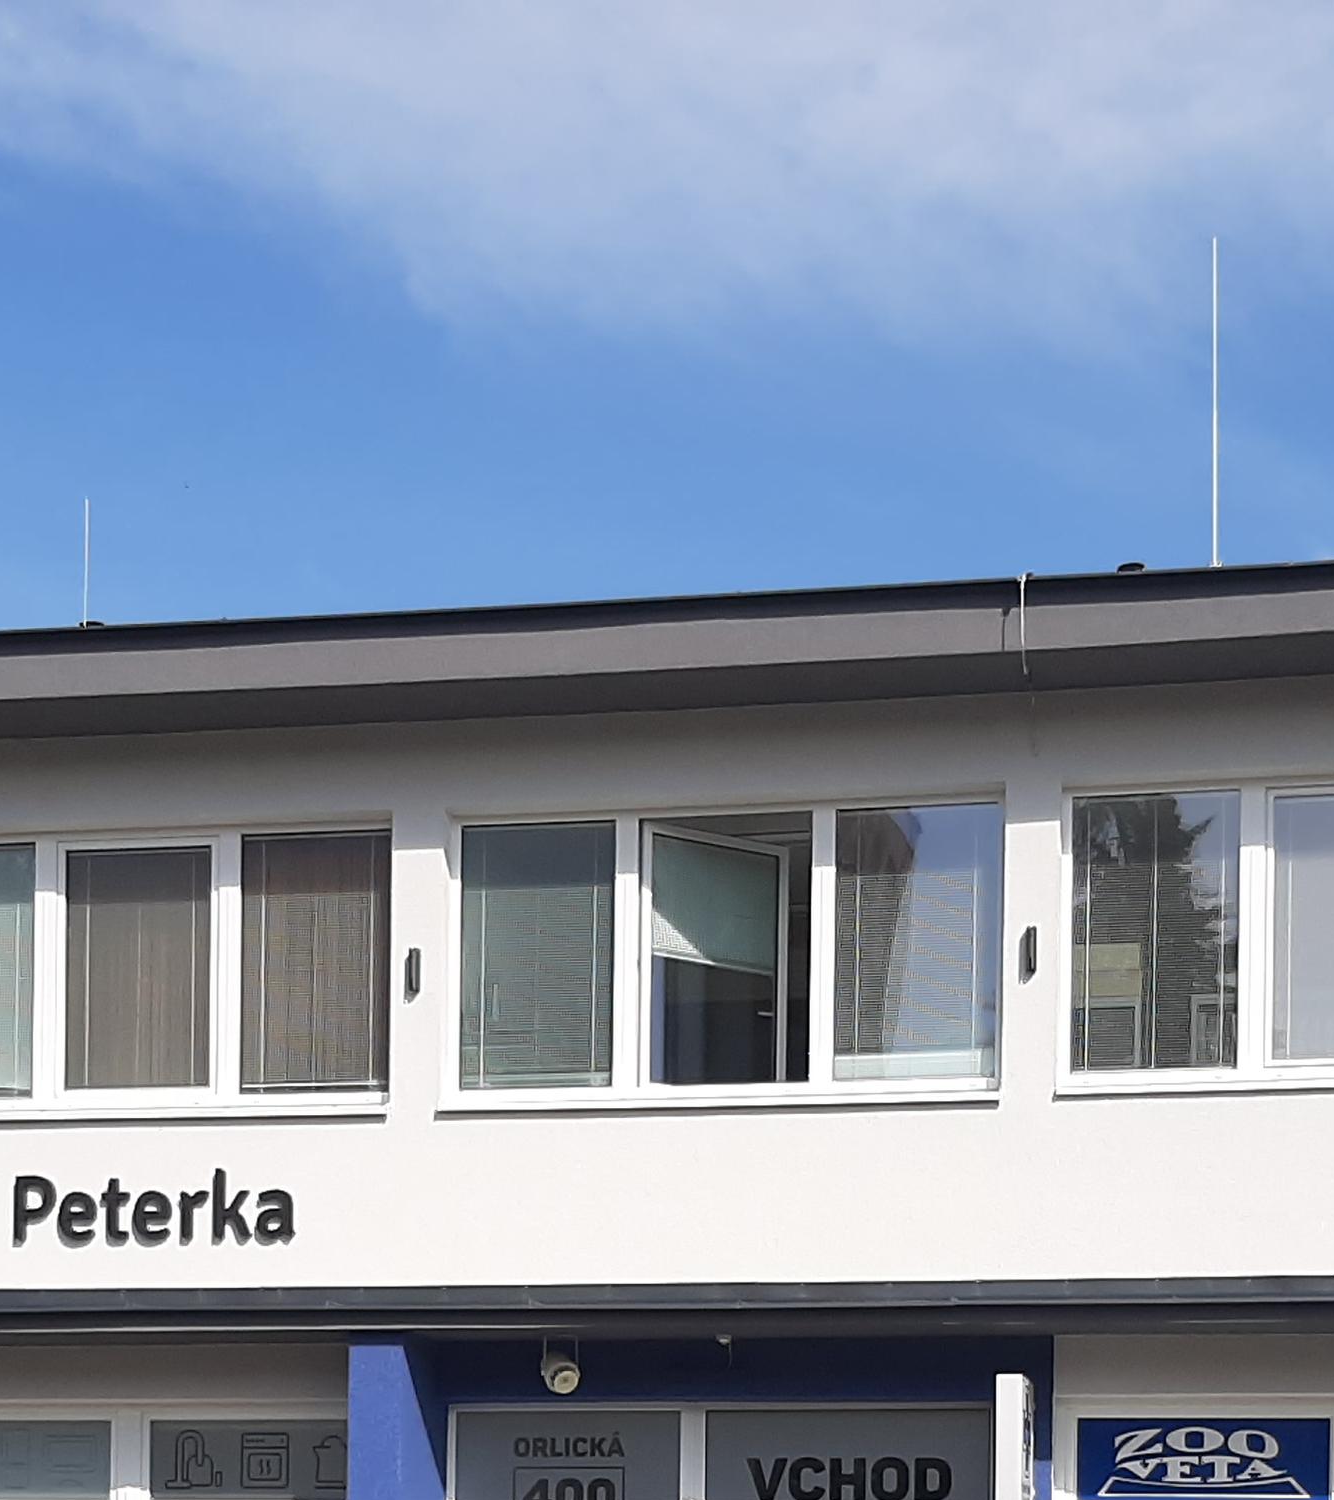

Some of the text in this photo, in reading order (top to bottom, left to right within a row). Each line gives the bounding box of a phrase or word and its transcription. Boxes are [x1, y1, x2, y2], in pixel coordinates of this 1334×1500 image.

[11, 1168, 297, 1250] Peterka
[513, 1431, 625, 1458] ORLICKÁ
[1113, 1426, 1280, 1460] ZOO
[1120, 1455, 1288, 1482] VETA
